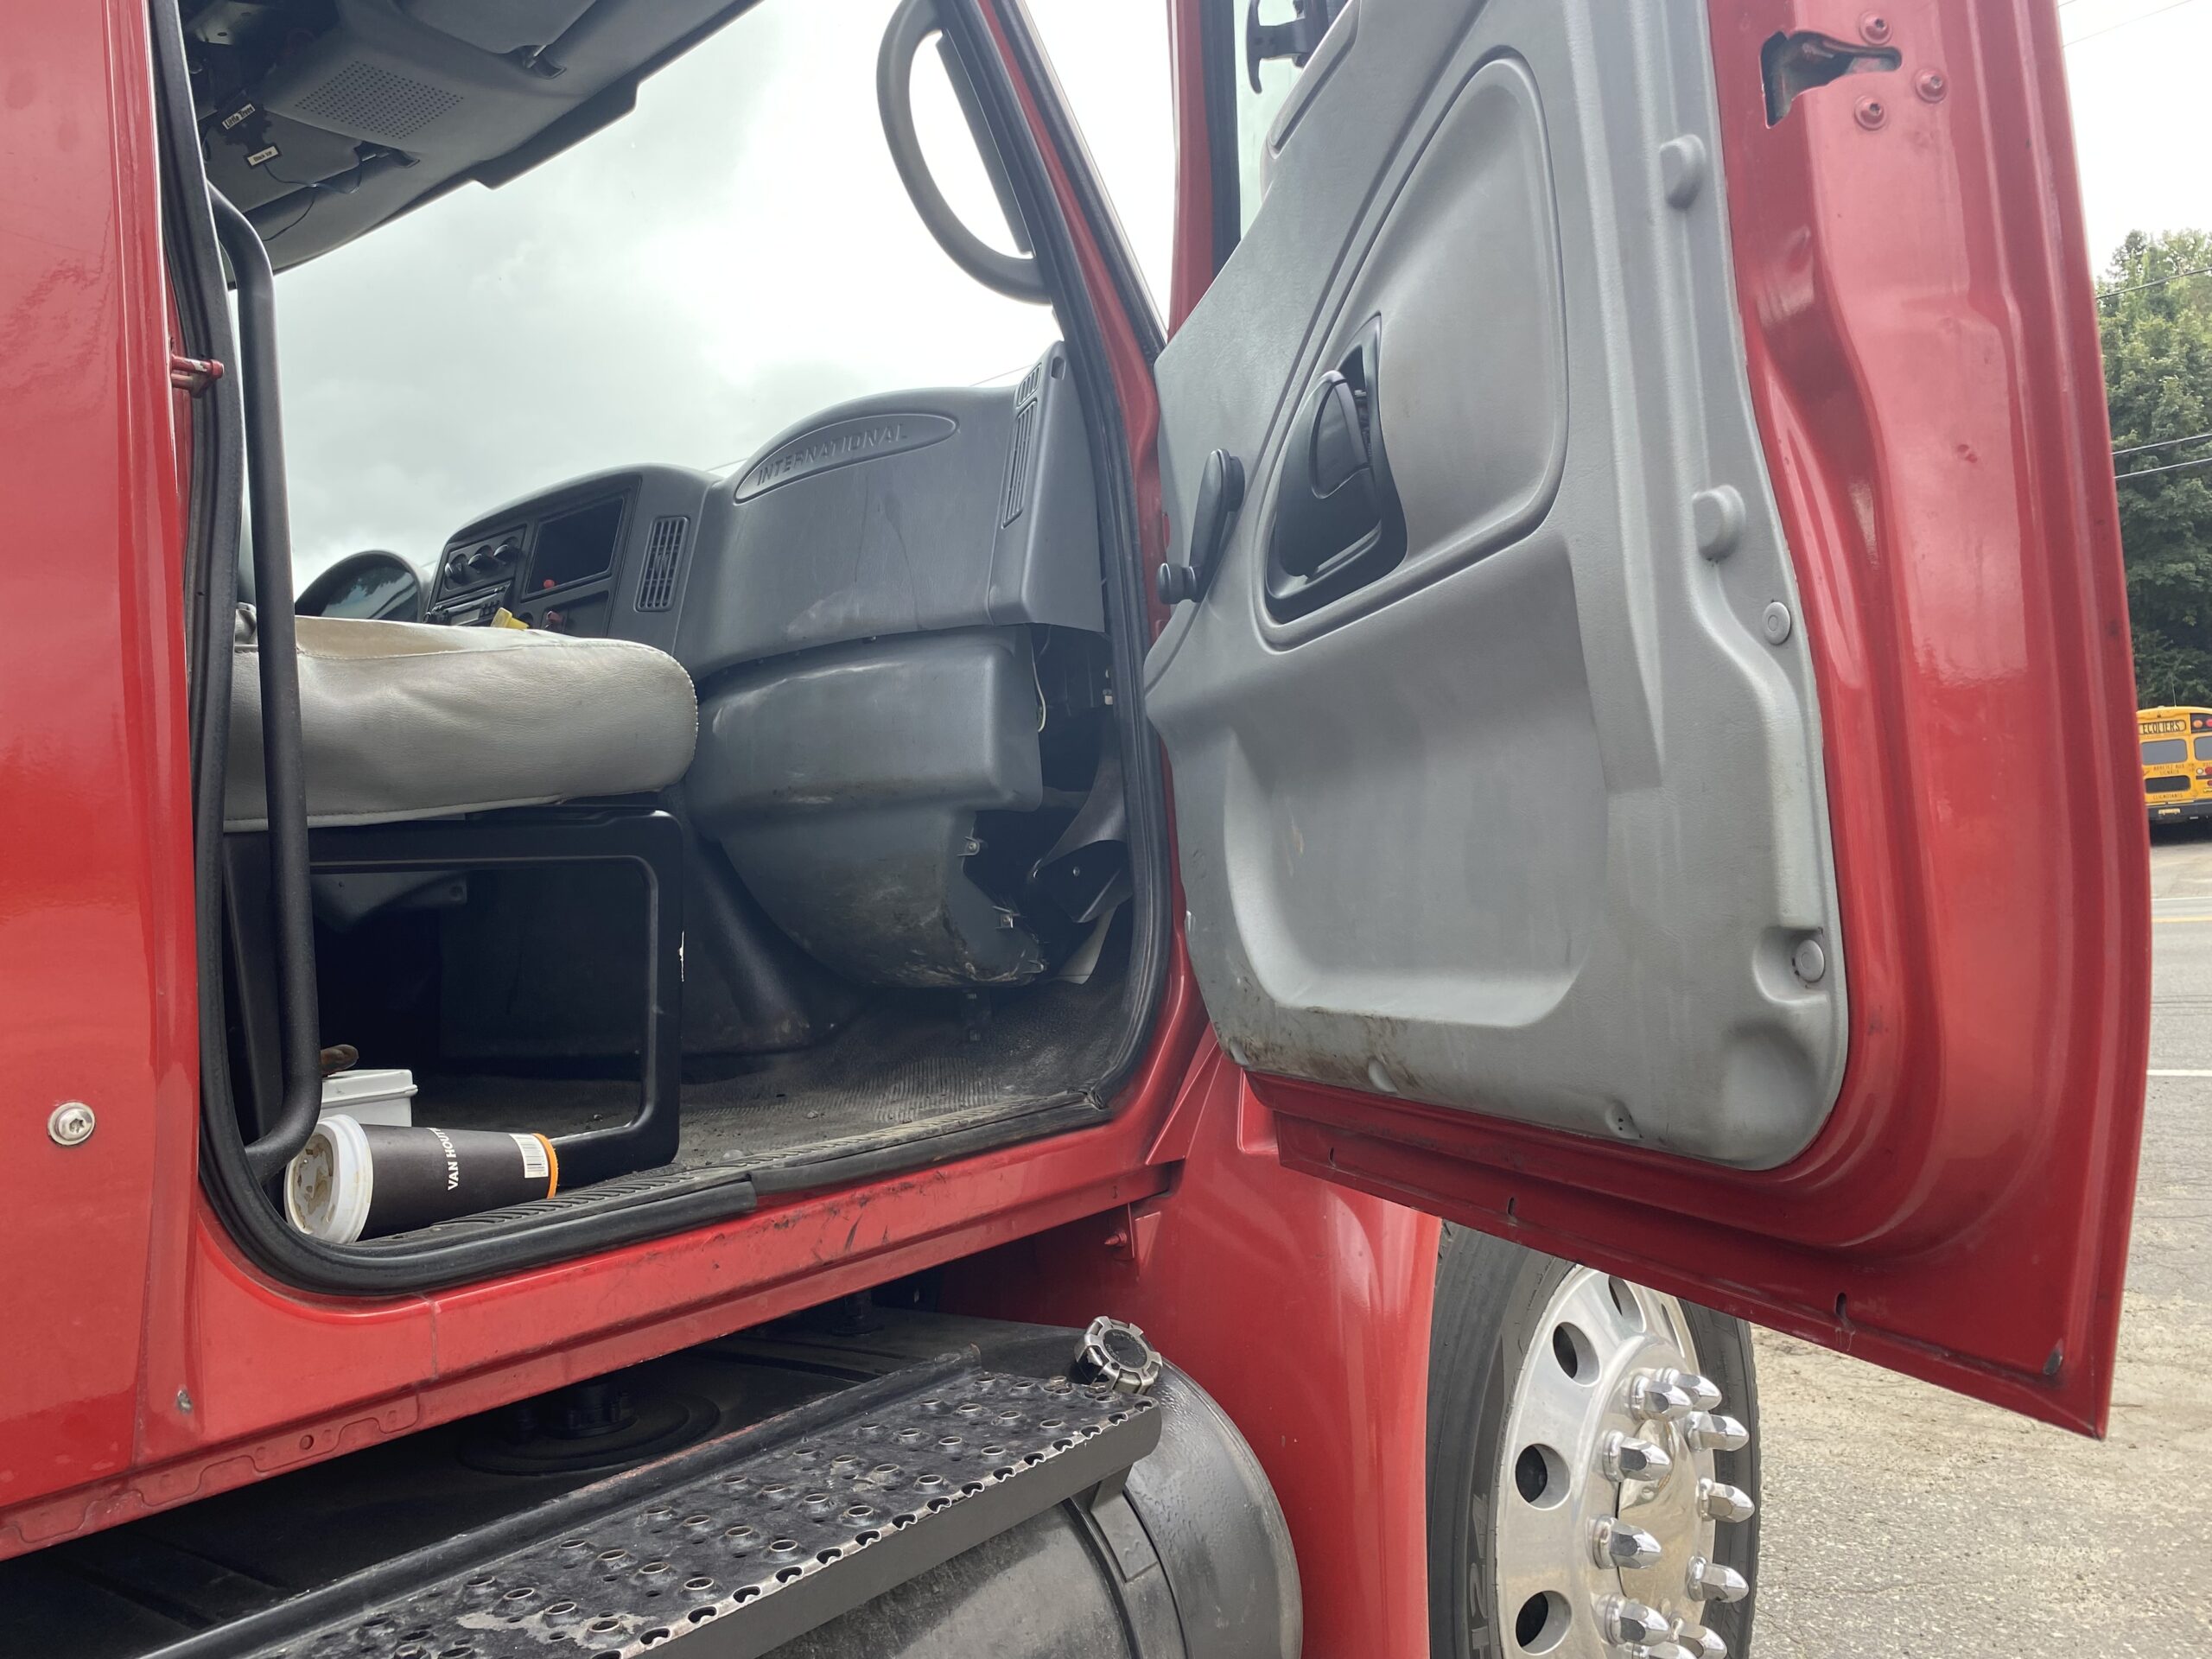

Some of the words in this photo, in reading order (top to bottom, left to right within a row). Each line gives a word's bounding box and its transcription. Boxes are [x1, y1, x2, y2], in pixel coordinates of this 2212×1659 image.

[757, 423, 907, 486] INTERNATIONAL
[426, 1127, 457, 1158] HOUTT
[448, 1161, 459, 1191] VAN
